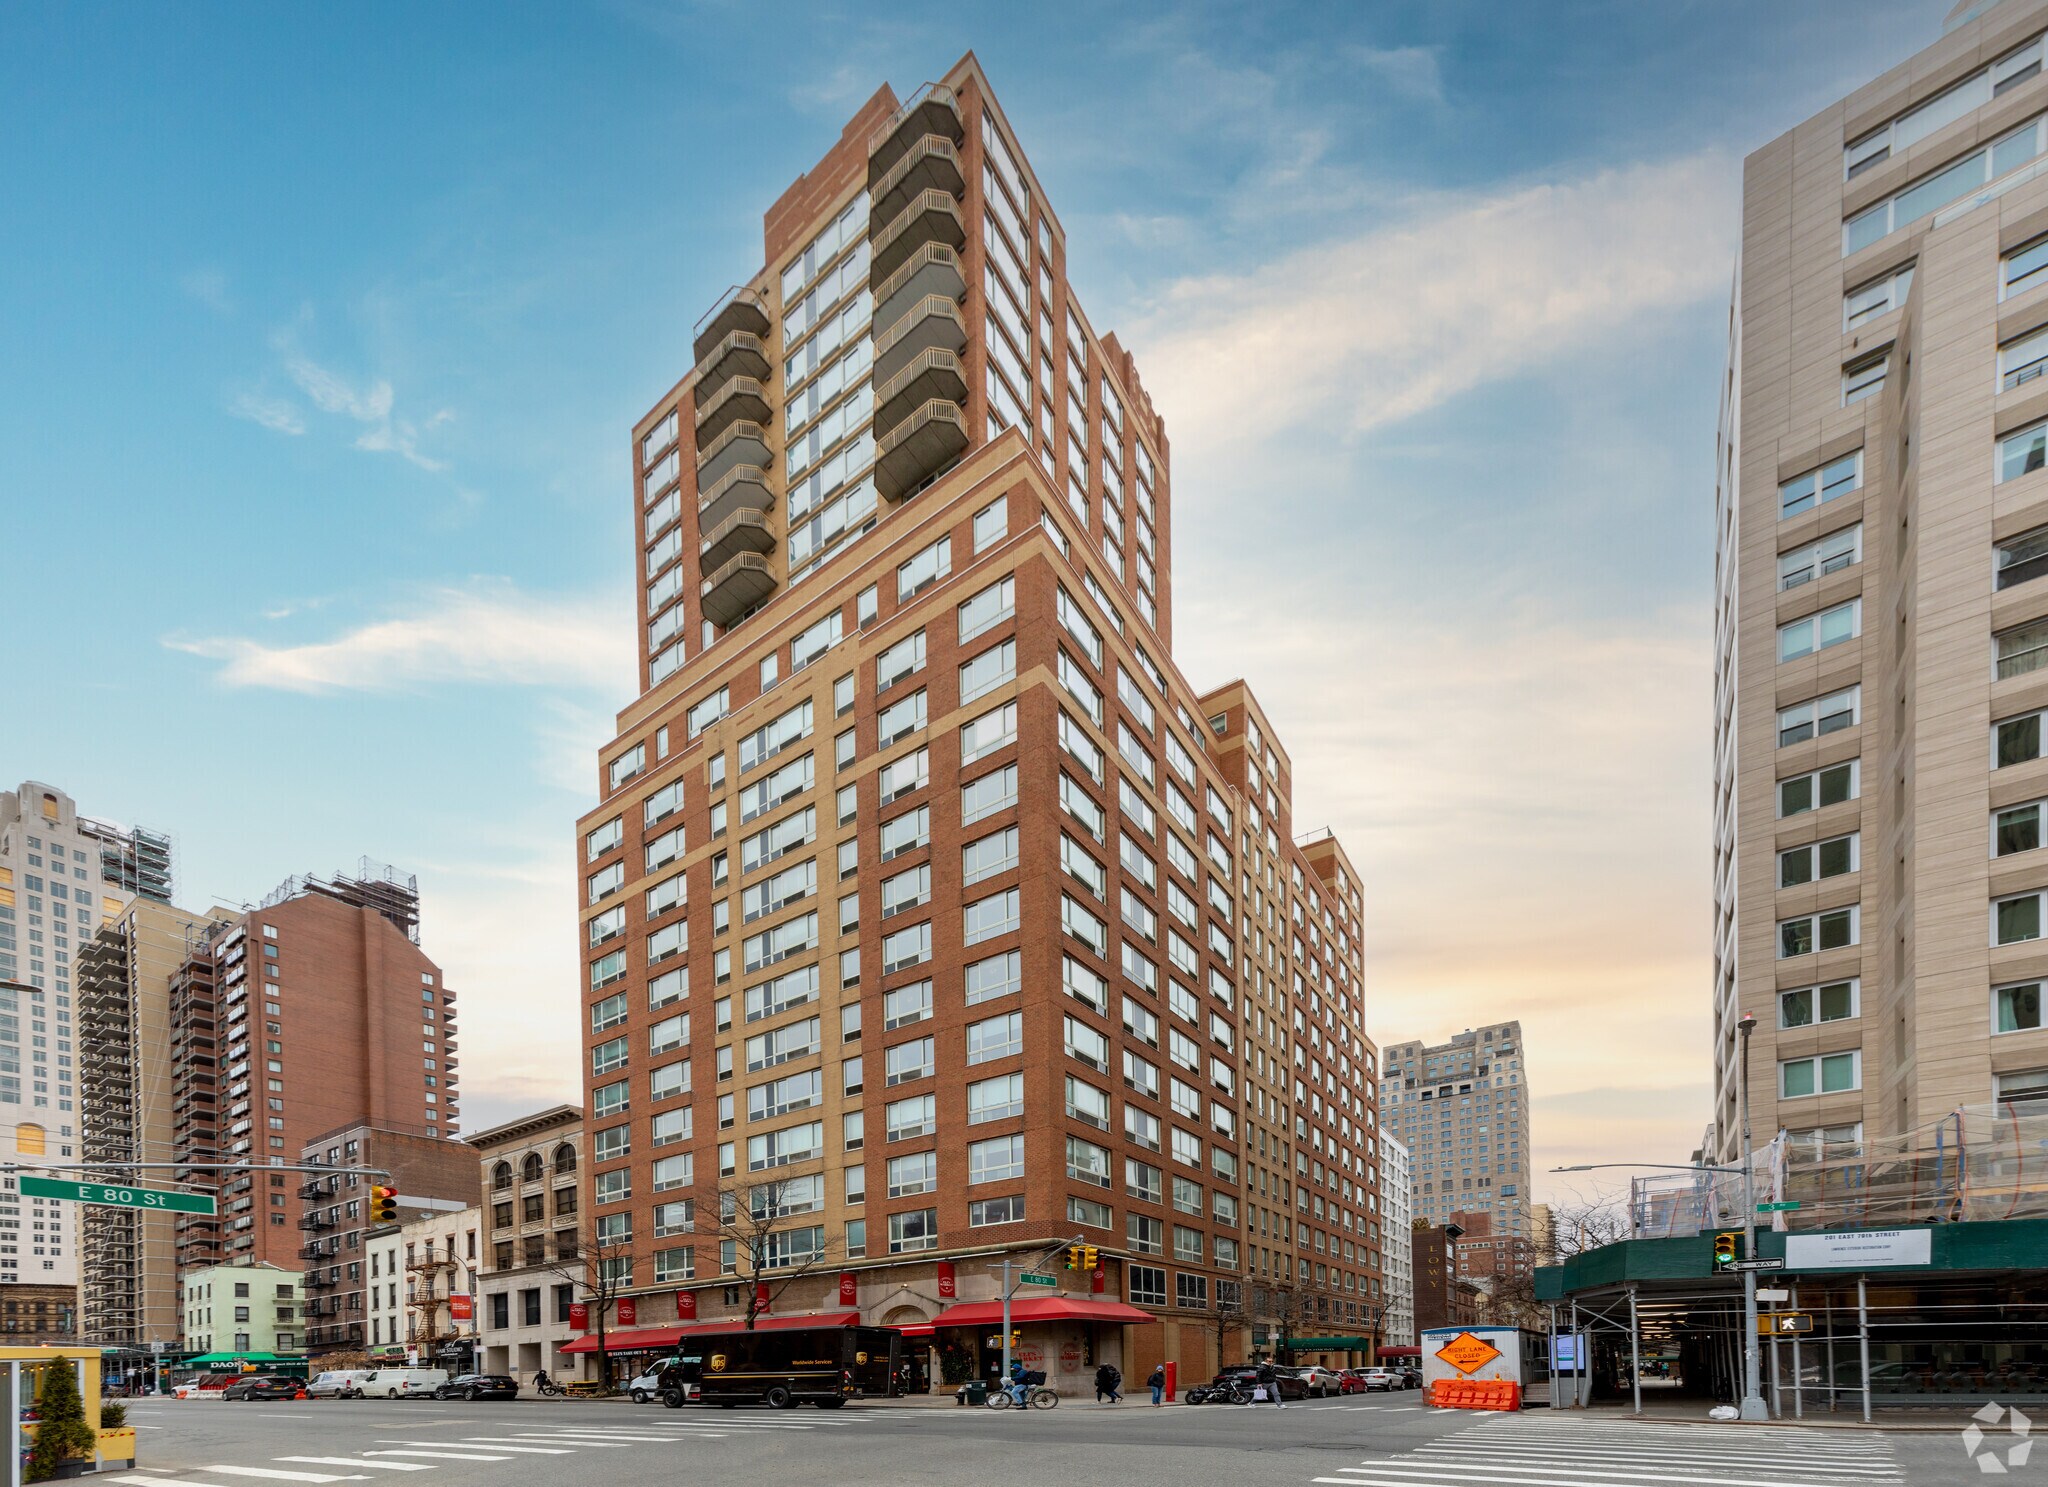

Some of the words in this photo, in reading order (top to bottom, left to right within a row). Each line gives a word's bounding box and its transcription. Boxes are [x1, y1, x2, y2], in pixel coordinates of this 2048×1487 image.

[78, 1185, 92, 1199] E
[103, 1188, 133, 1203] 80
[143, 1193, 166, 1207] St
[1768, 1203, 1775, 1211] 3
[1428, 1245, 1440, 1288] LOWY
[1034, 1276, 1042, 1284] 80
